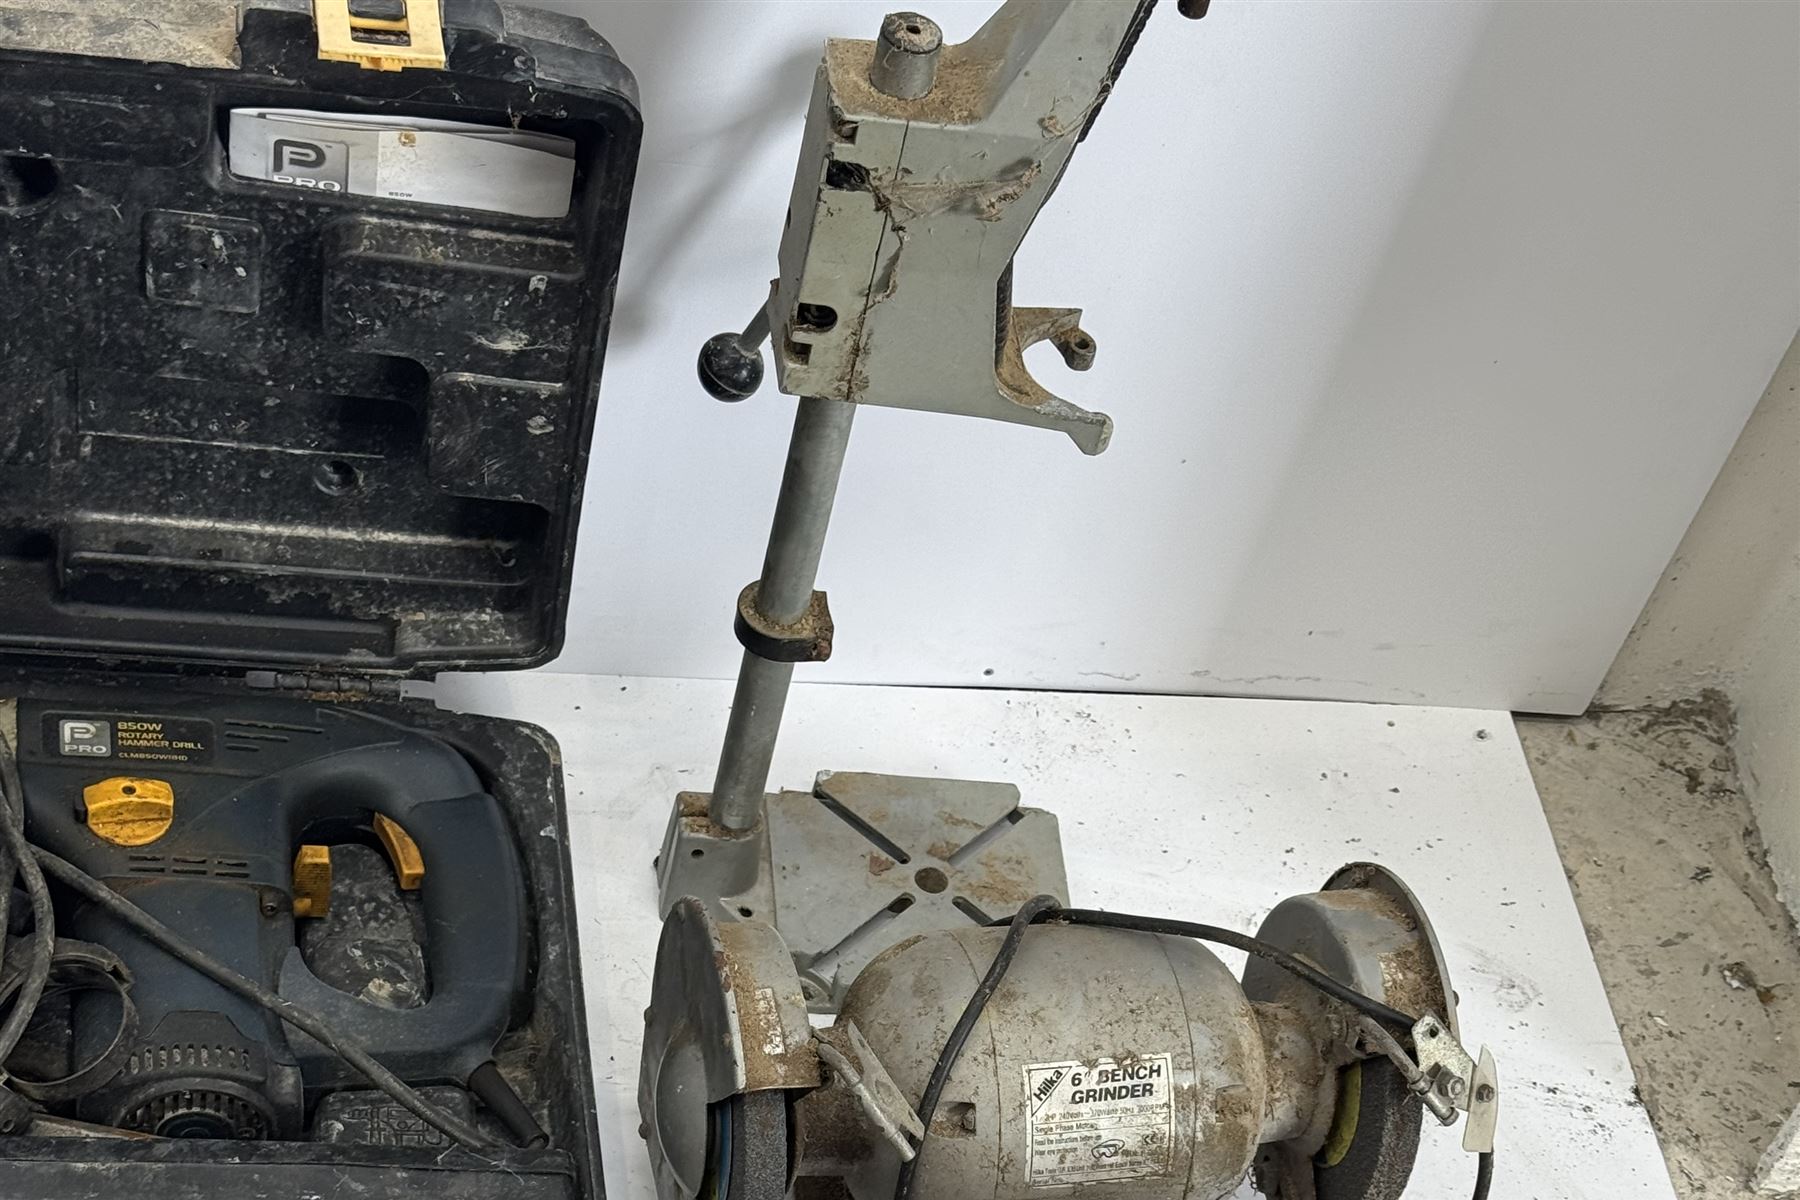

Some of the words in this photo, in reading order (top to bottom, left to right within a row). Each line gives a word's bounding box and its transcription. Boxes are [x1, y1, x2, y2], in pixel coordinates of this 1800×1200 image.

[117, 721, 162, 731] 850W
[118, 732, 165, 740] ROTARY
[63, 744, 108, 754] PRO
[118, 740, 169, 748] HAMMER
[172, 741, 205, 750] DRILL
[1071, 1070, 1091, 1087] 6"
[1096, 1064, 1162, 1086] BENCH
[1033, 1069, 1064, 1102] Hilka
[1070, 1083, 1154, 1105] GRINDER
